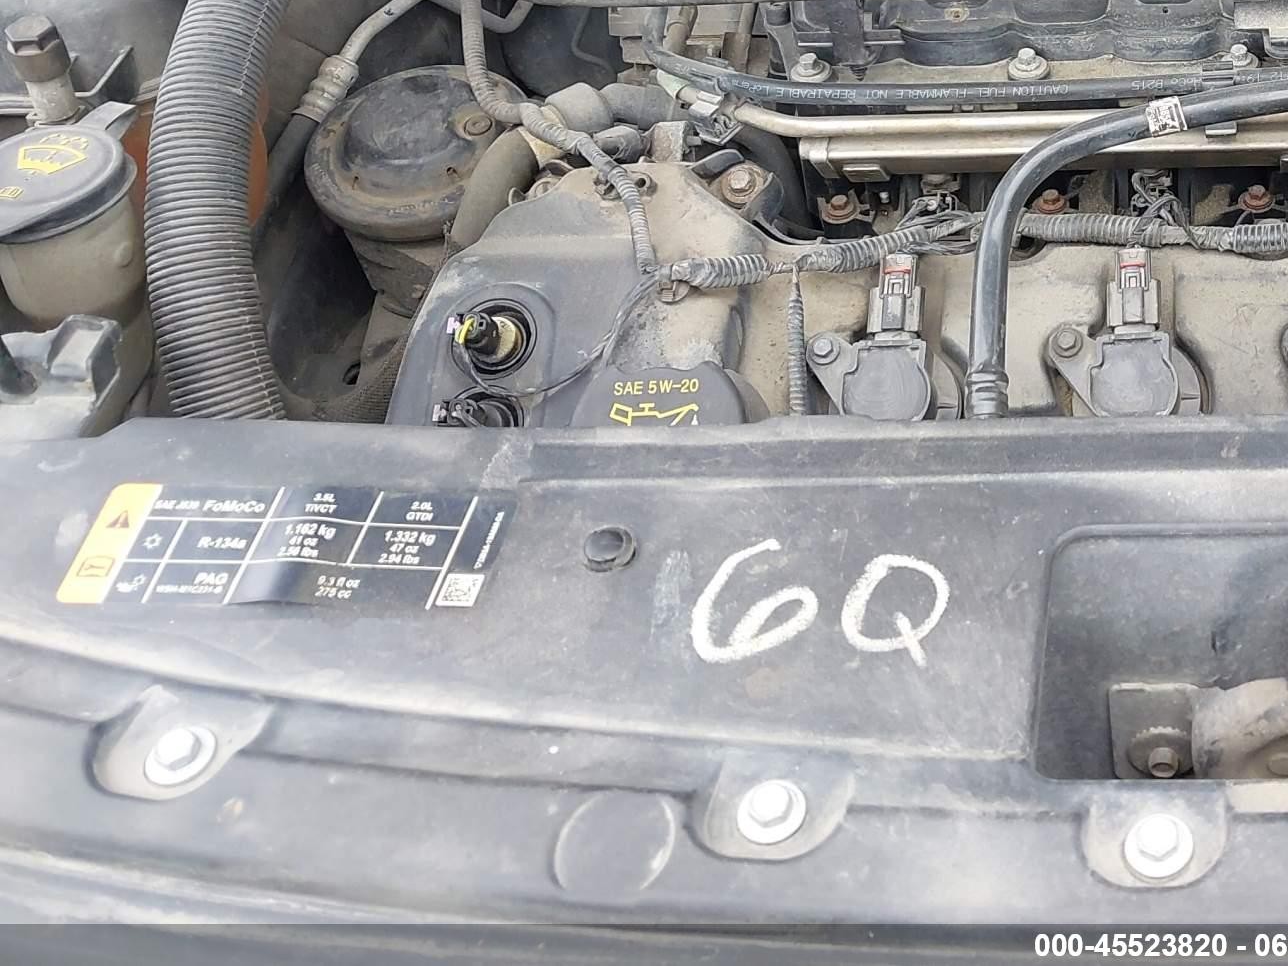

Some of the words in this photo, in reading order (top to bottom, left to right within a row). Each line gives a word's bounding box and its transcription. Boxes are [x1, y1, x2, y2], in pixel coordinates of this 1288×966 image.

[776, 87, 857, 99] REPAIRABLE
[865, 89, 888, 99] NOT
[1012, 84, 1069, 96] CAUTION
[614, 381, 644, 395] SAE
[202, 500, 266, 513] FoMoCo
[410, 501, 433, 511] 2.0L
[285, 523, 318, 535] 1.162
[318, 524, 336, 540] kg
[197, 536, 248, 549] R-134a
[303, 537, 319, 546] oz
[384, 530, 419, 543] 1.332
[418, 531, 437, 546] kg
[301, 547, 319, 558] lbs
[389, 543, 405, 553] 47
[405, 545, 420, 554] oz
[378, 553, 402, 564] 2.94
[402, 554, 420, 565] lbs
[193, 572, 229, 585] PAG
[346, 579, 360, 588] oz
[315, 586, 337, 598] 275
[337, 589, 353, 599] cc
